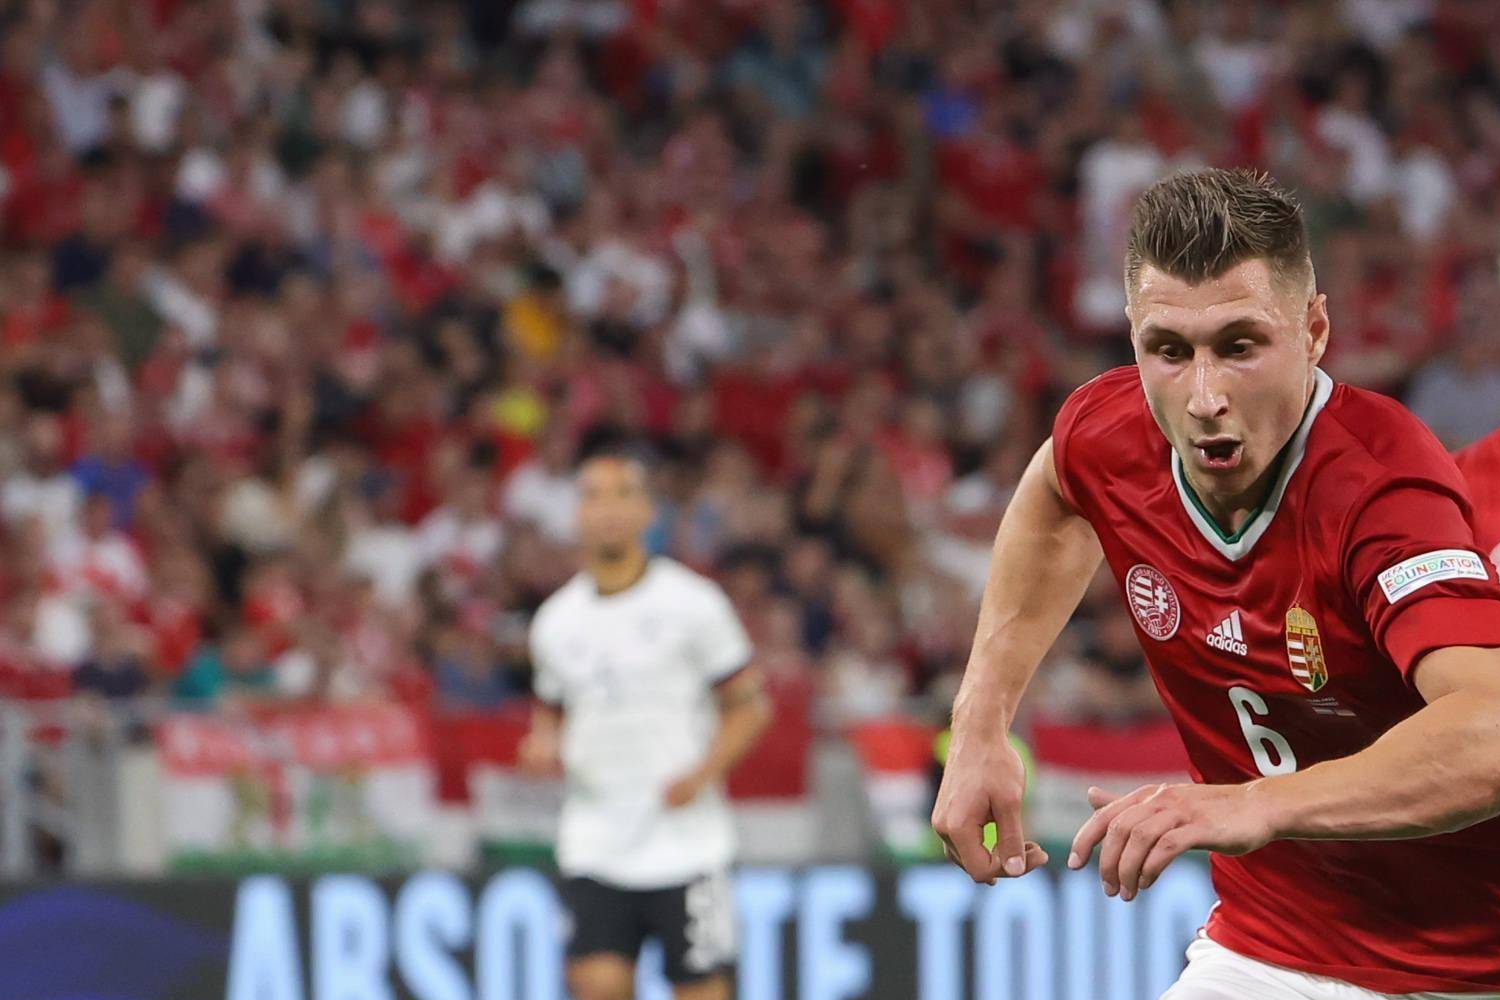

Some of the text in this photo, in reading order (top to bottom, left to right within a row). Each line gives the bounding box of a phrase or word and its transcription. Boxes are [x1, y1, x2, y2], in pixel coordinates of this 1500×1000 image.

[1385, 558, 1482, 592] FOUNDATION
[1206, 633, 1248, 656] adidas
[1228, 686, 1298, 778] 6
